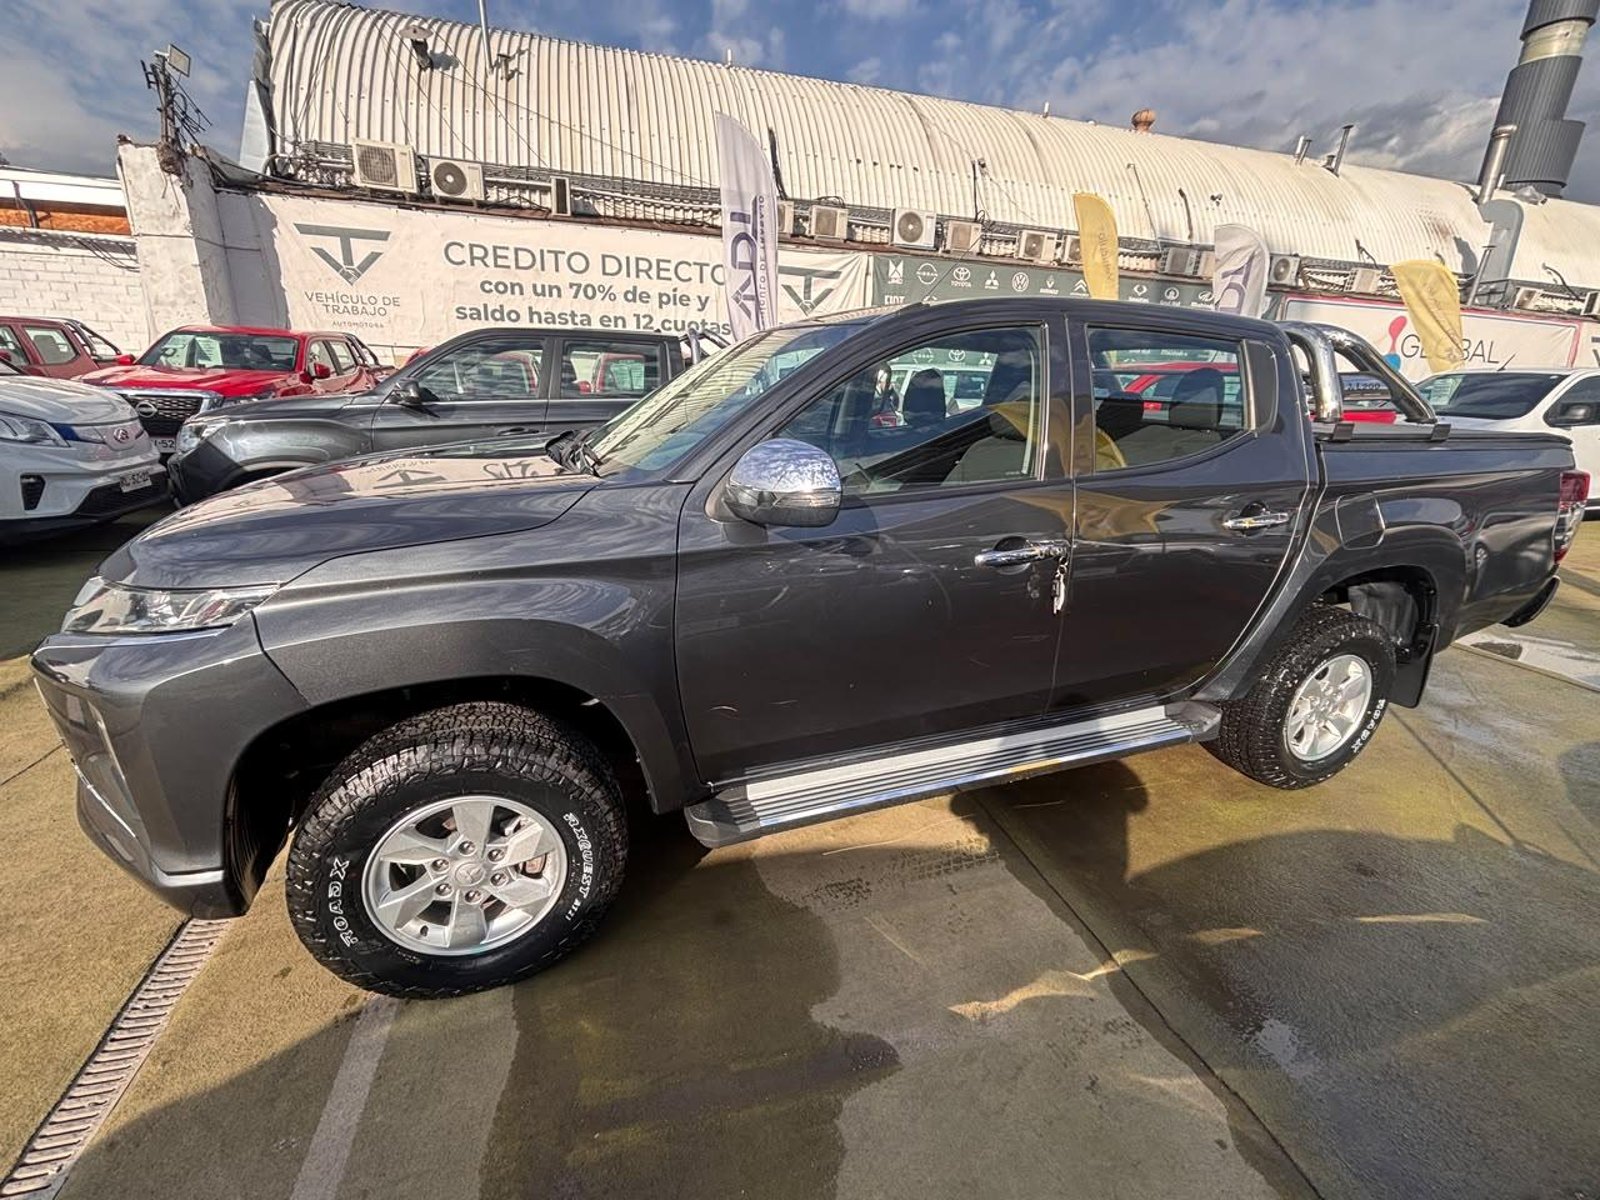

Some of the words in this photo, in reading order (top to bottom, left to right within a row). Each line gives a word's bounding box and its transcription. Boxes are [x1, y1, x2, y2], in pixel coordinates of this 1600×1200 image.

[444, 241, 590, 274] CREDITO
[600, 254, 725, 286] DIRECTO
[304, 290, 378, 306] VEHÍCULO
[382, 296, 401, 307] DE
[480, 280, 524, 295] con
[532, 283, 562, 298] un
[568, 282, 617, 302] 70%
[623, 285, 651, 304] de
[697, 295, 710, 312] y
[951, 280, 972, 288] TOYOTA
[321, 303, 387, 317] TRABAJO
[332, 320, 385, 329] AUTOMOTORA
[455, 303, 521, 323] saldo
[527, 306, 592, 327] hasta
[599, 314, 627, 329] en
[633, 313, 655, 331] 12
[660, 318, 732, 336] cuotas
[1401, 334, 1500, 364] GLBAL
[329, 857, 359, 947] ROADX
